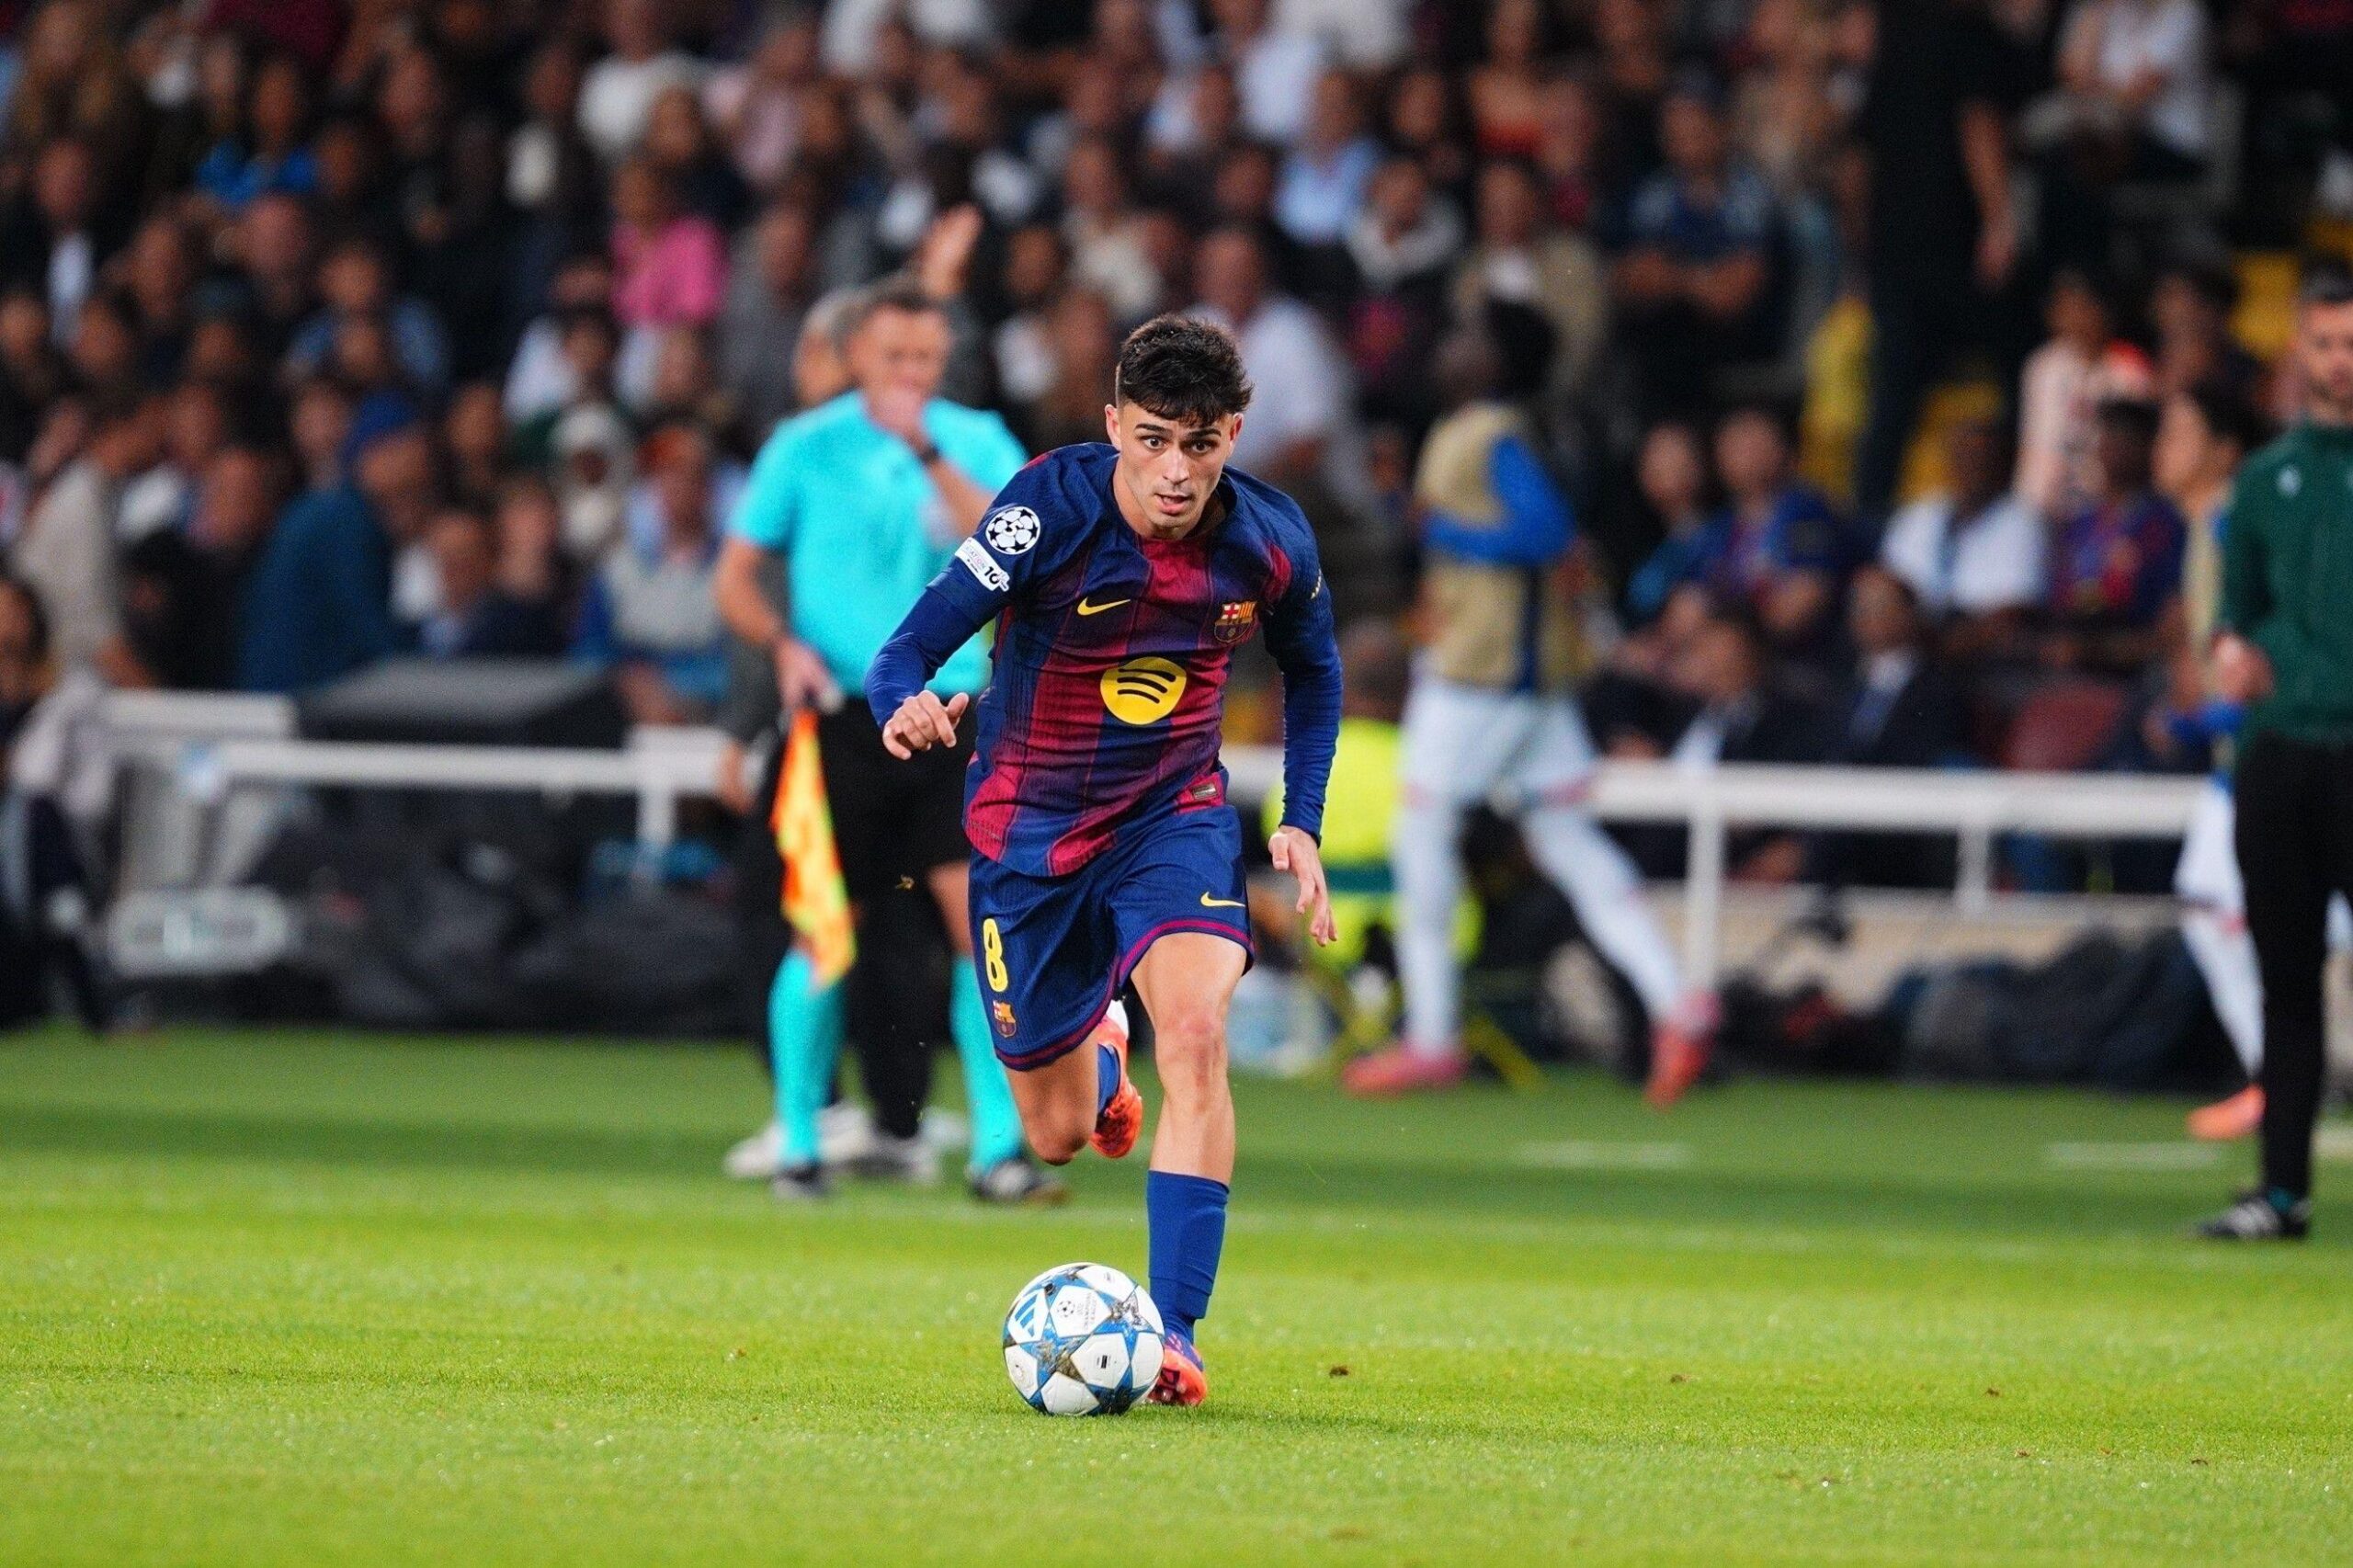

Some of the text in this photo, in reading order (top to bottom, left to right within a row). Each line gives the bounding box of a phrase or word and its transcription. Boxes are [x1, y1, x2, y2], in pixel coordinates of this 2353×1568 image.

[1003, 519, 1024, 537] 5
[983, 566, 1001, 585] 10
[983, 918, 1008, 993] 8
